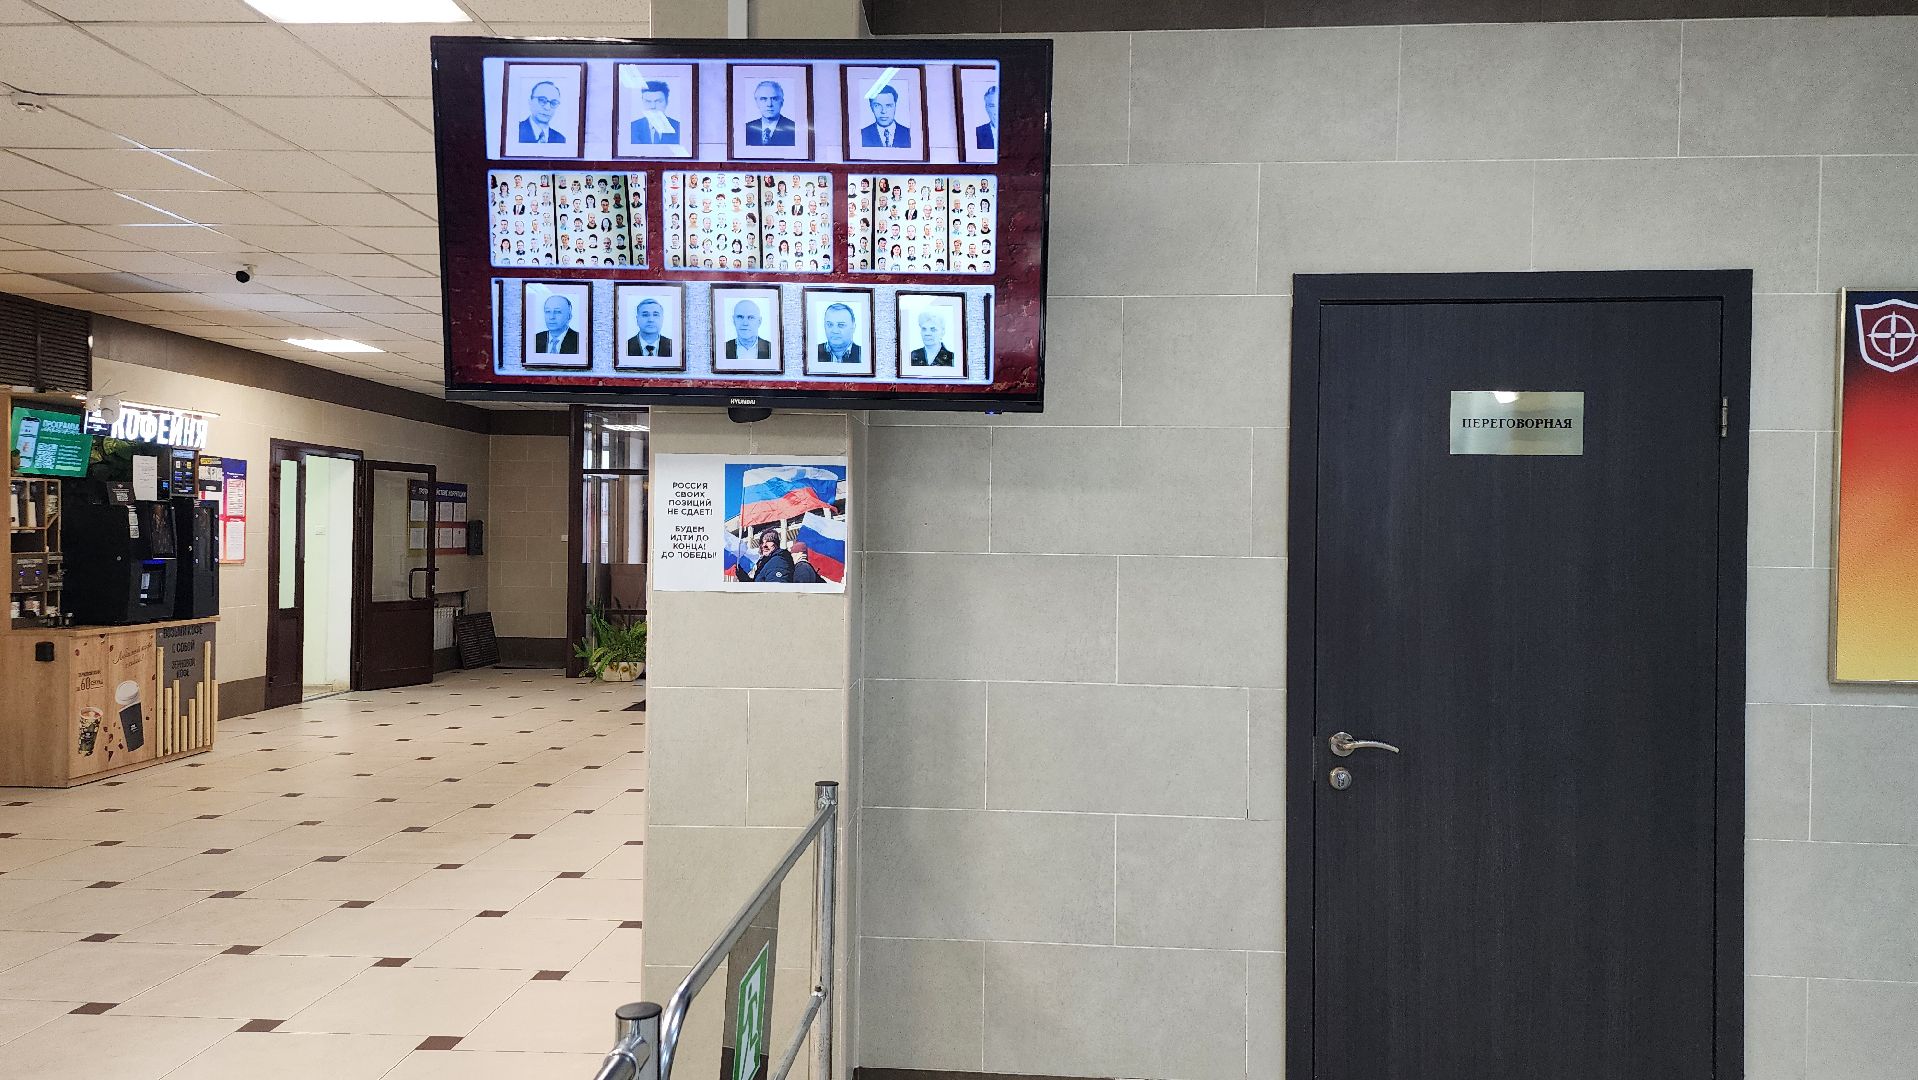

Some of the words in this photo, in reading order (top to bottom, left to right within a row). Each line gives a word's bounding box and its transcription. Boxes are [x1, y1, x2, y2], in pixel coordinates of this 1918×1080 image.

[1462, 418, 1573, 429] ПЕРЕГОВОРНАЯ
[672, 482, 708, 490] РОССИЯ
[668, 498, 712, 507] ПОЗИЦИЙ
[681, 508, 713, 516] СДАЕТ!
[675, 526, 705, 534] БУДЕМ
[673, 543, 706, 551] КОНЦА!
[661, 551, 675, 559] ДО
[677, 551, 717, 560] ПОБЕДЫ!
[80, 677, 91, 690] 60
